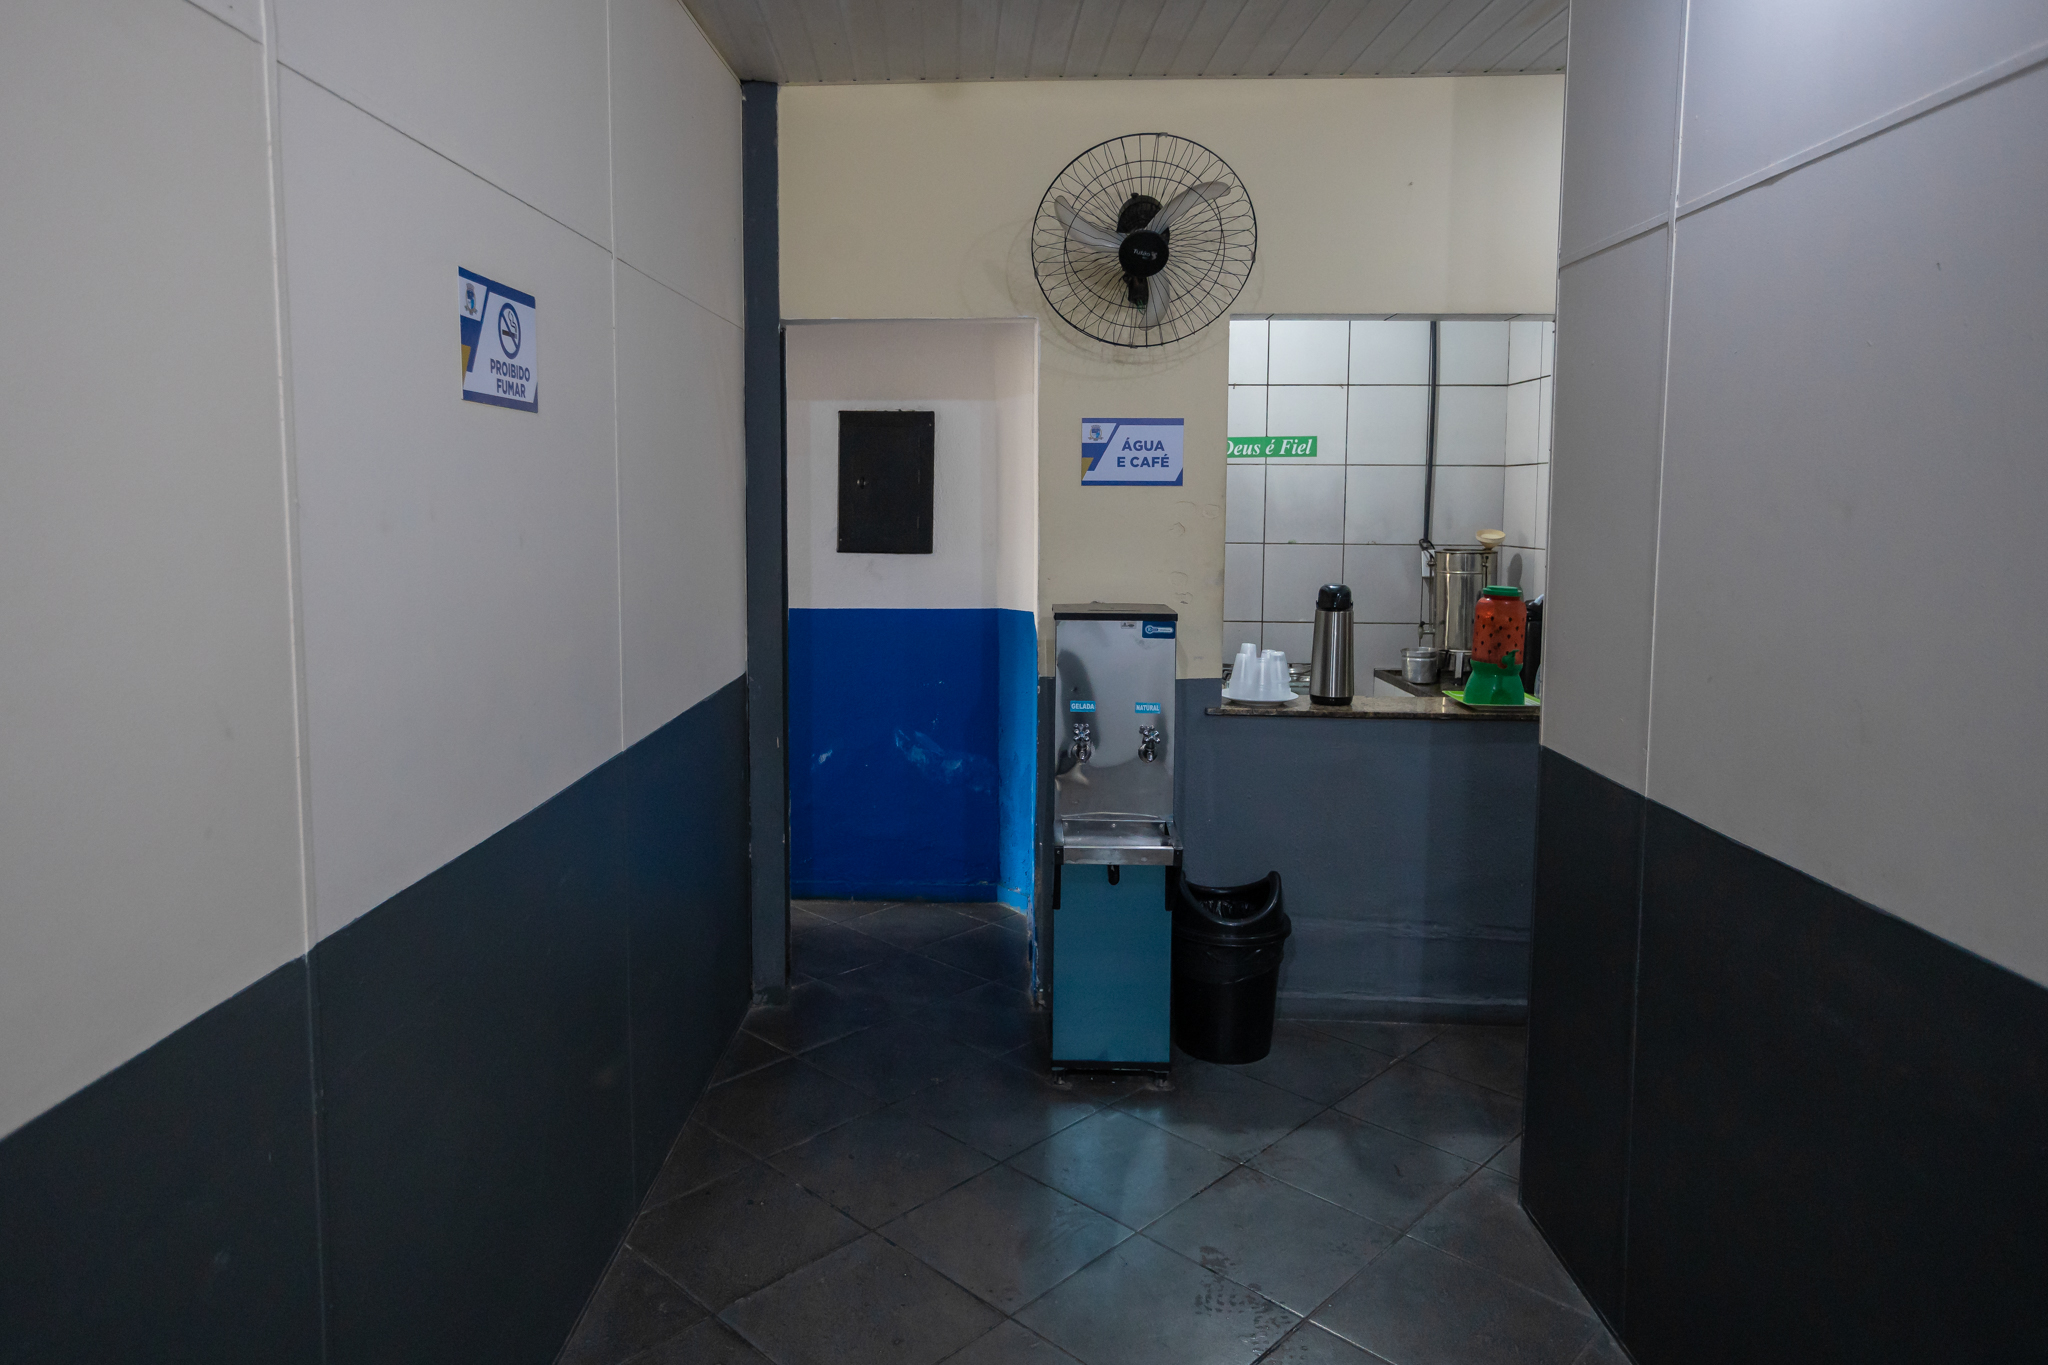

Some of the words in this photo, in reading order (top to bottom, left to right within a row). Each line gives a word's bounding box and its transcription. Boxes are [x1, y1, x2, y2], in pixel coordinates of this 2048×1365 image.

[490, 358, 531, 382] PROIBIDO
[496, 378, 526, 399] FUMAR
[1121, 437, 1165, 452] ÁGUA
[1265, 439, 1276, 455] é
[1279, 438, 1313, 455] Fiel
[1117, 456, 1126, 468] E
[1130, 454, 1170, 468] CAFÉ
[1070, 702, 1095, 710] GELADA
[1135, 704, 1160, 712] NATURAL
